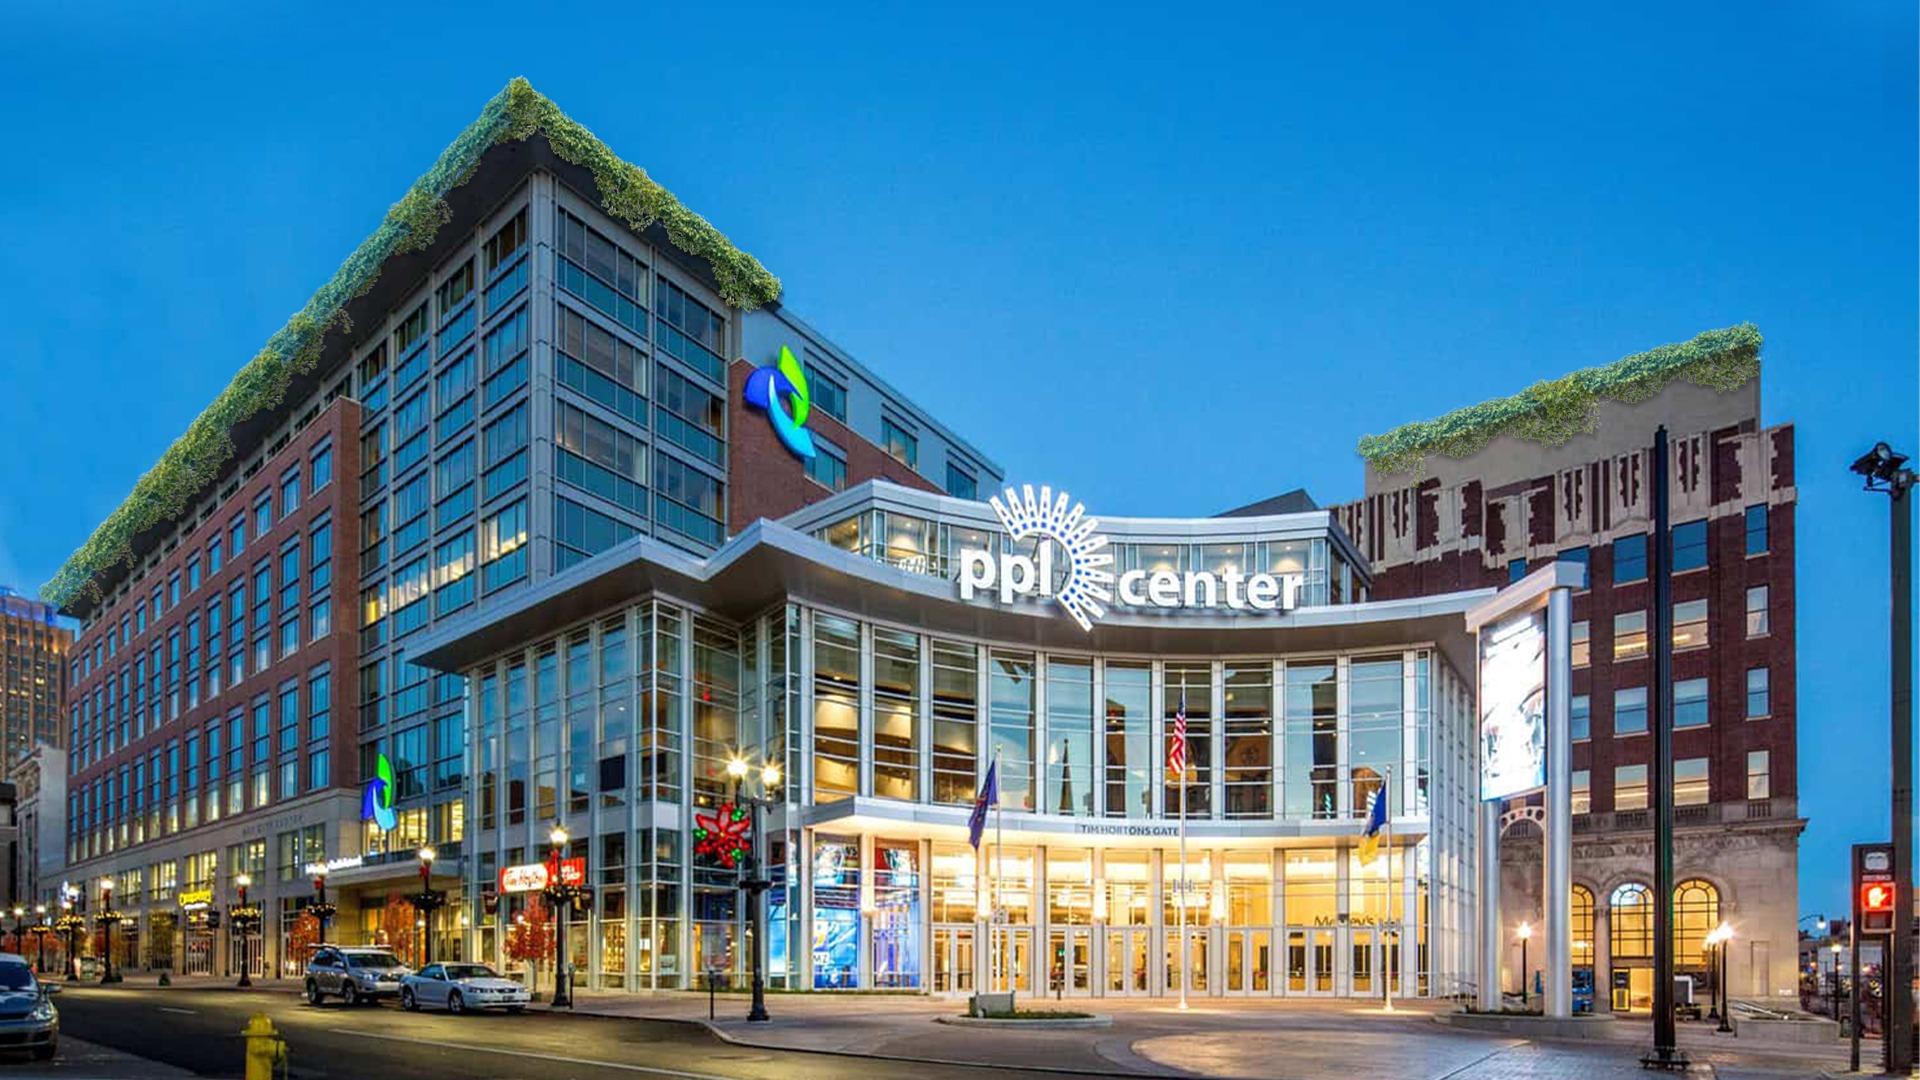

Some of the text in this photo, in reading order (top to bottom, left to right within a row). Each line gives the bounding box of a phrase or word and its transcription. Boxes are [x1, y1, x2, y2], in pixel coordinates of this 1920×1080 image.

[960, 540, 1304, 610] ppl center
[1081, 825, 1180, 837] TIM HORTONS GATE
